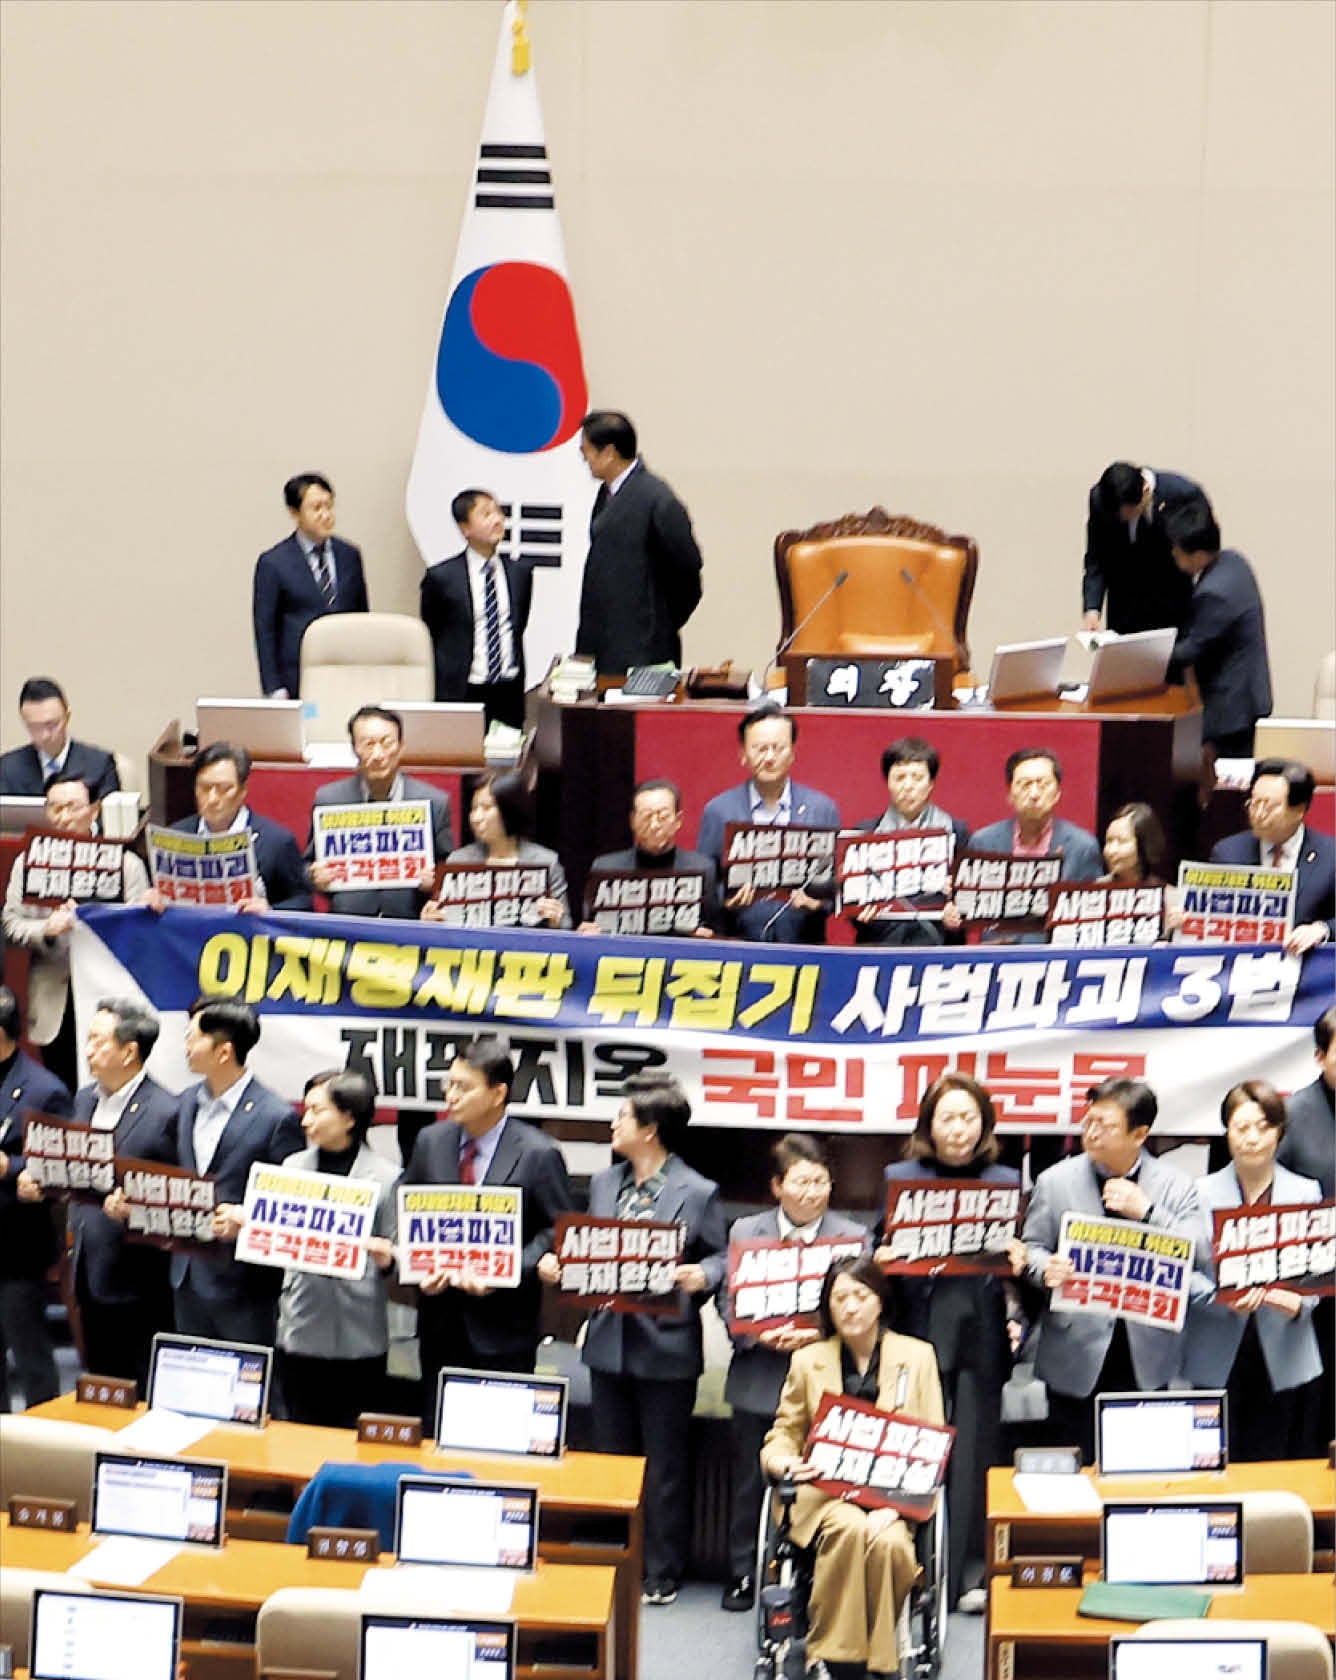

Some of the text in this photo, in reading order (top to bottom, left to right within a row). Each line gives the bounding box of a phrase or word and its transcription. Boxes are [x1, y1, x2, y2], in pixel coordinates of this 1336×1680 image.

[199, 932, 575, 1019] 이재명재판
[587, 956, 820, 1034] 뒤집기
[830, 957, 1148, 1037] 사법파괴
[702, 1048, 865, 1122] 국민
[252, 1198, 364, 1236] 사법파괴
[409, 1217, 514, 1245] 사법파괴
[1069, 1247, 1183, 1290] 사법파괴
